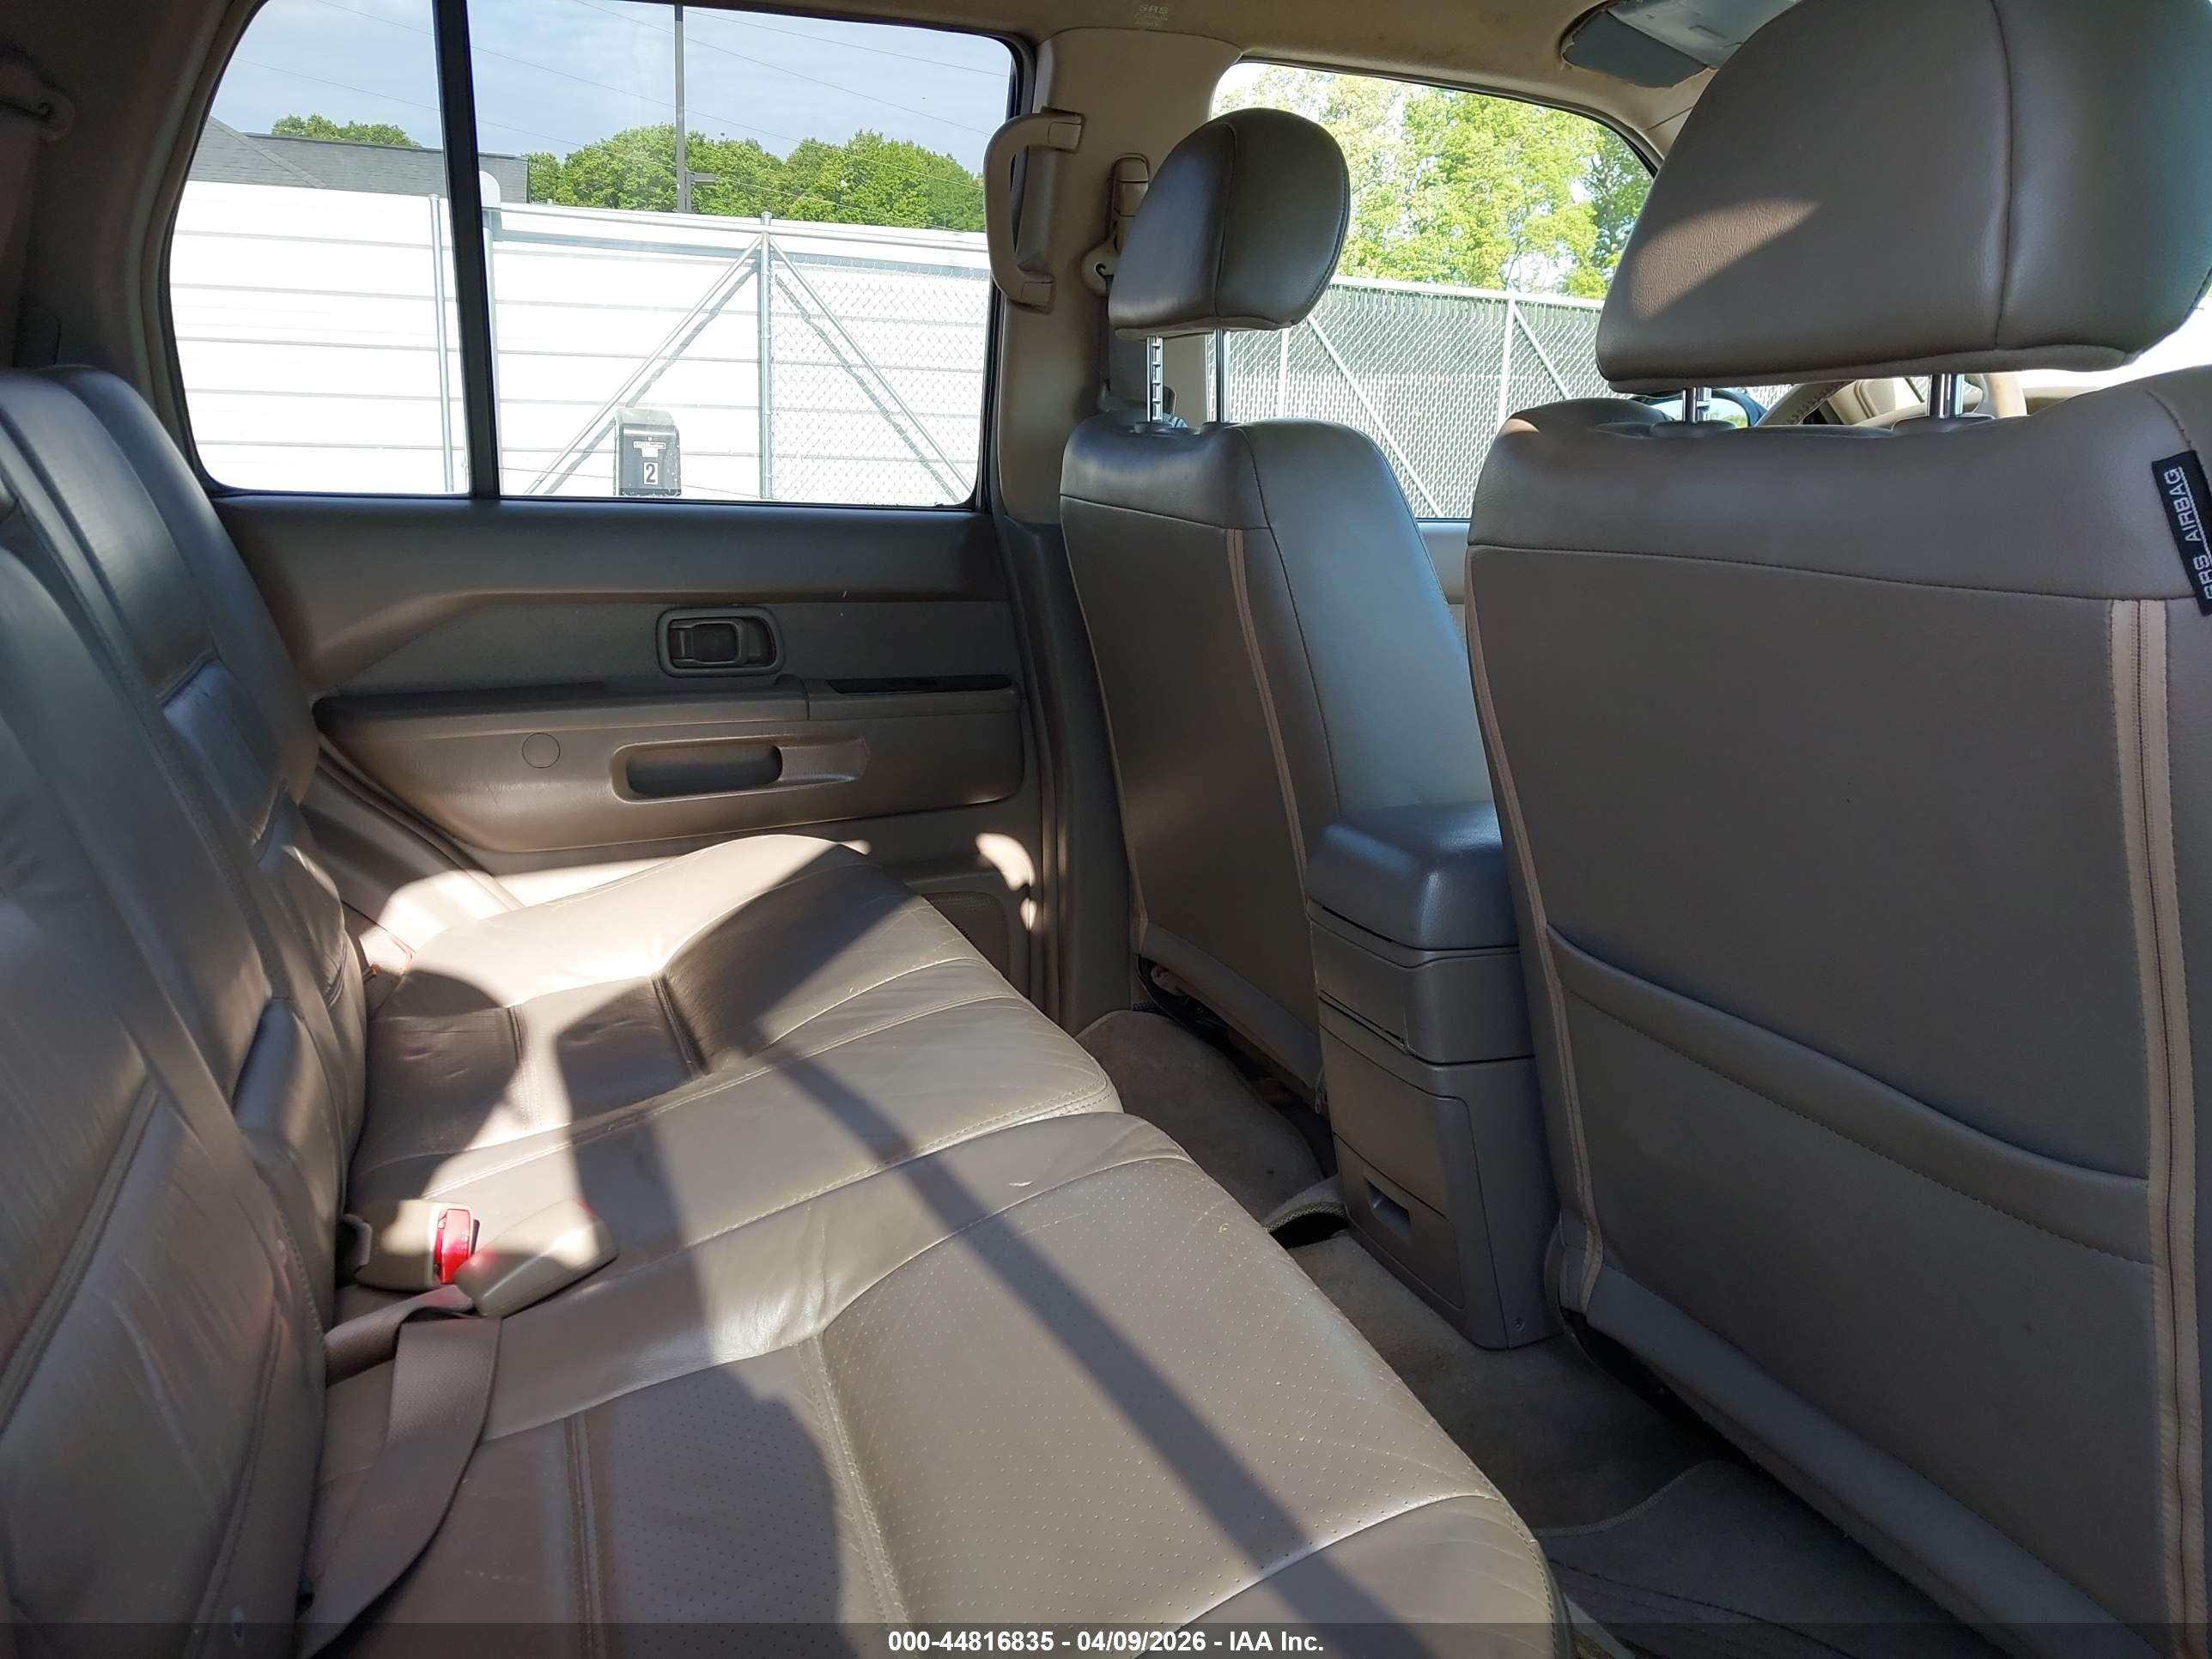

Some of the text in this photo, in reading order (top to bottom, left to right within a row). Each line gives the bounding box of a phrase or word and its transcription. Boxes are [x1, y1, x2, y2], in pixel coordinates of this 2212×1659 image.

[1139, 4, 1168, 15] SRS
[646, 464, 656, 483] 2
[2164, 466, 2202, 543] AIRBAG
